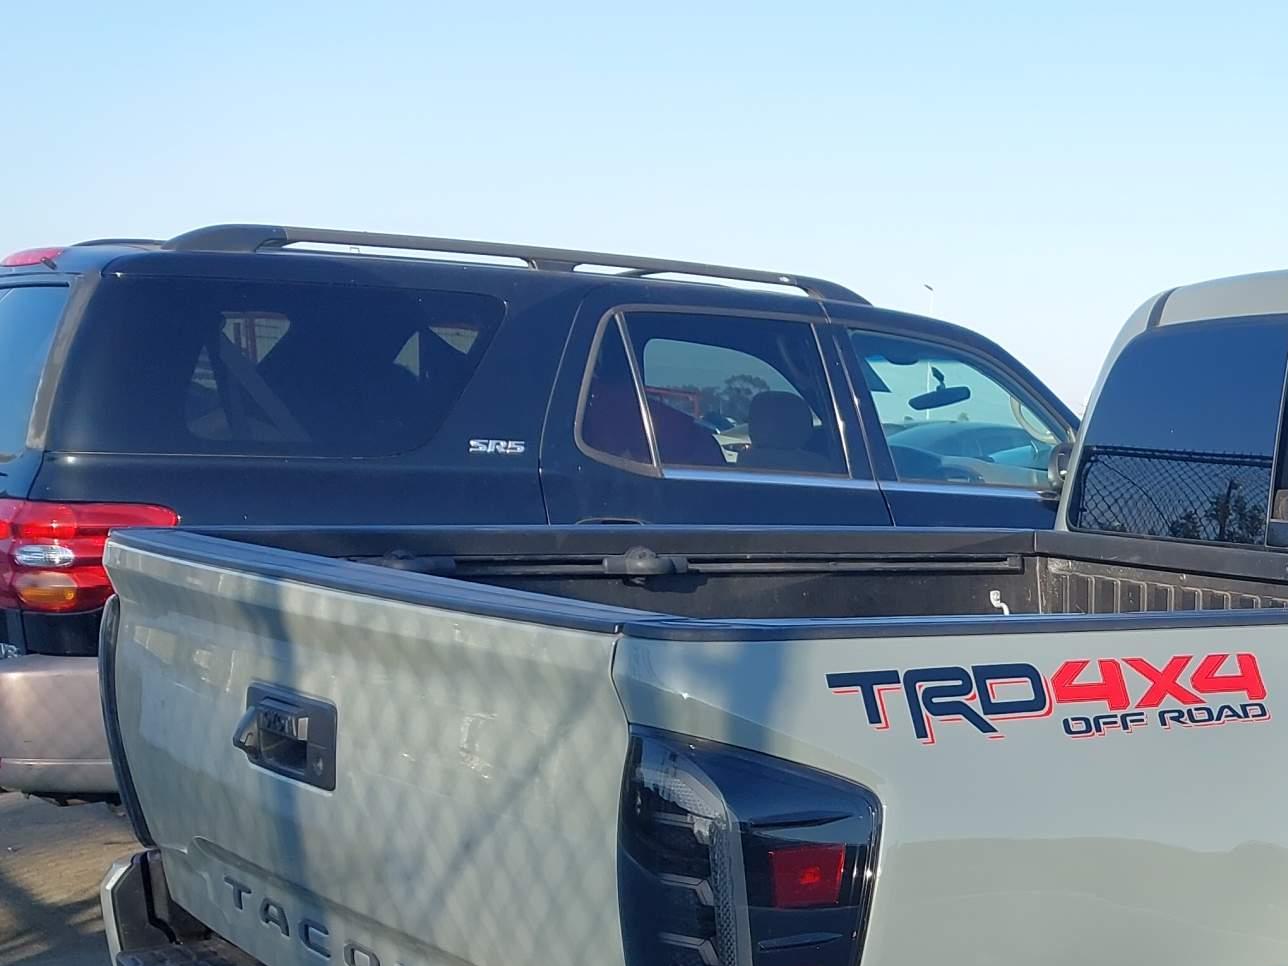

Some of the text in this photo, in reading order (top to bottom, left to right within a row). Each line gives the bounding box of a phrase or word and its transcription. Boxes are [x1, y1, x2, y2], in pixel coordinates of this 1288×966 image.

[468, 438, 526, 453] SR5
[825, 661, 1053, 744] TRD
[1061, 702, 1271, 738] OFF ROAD
